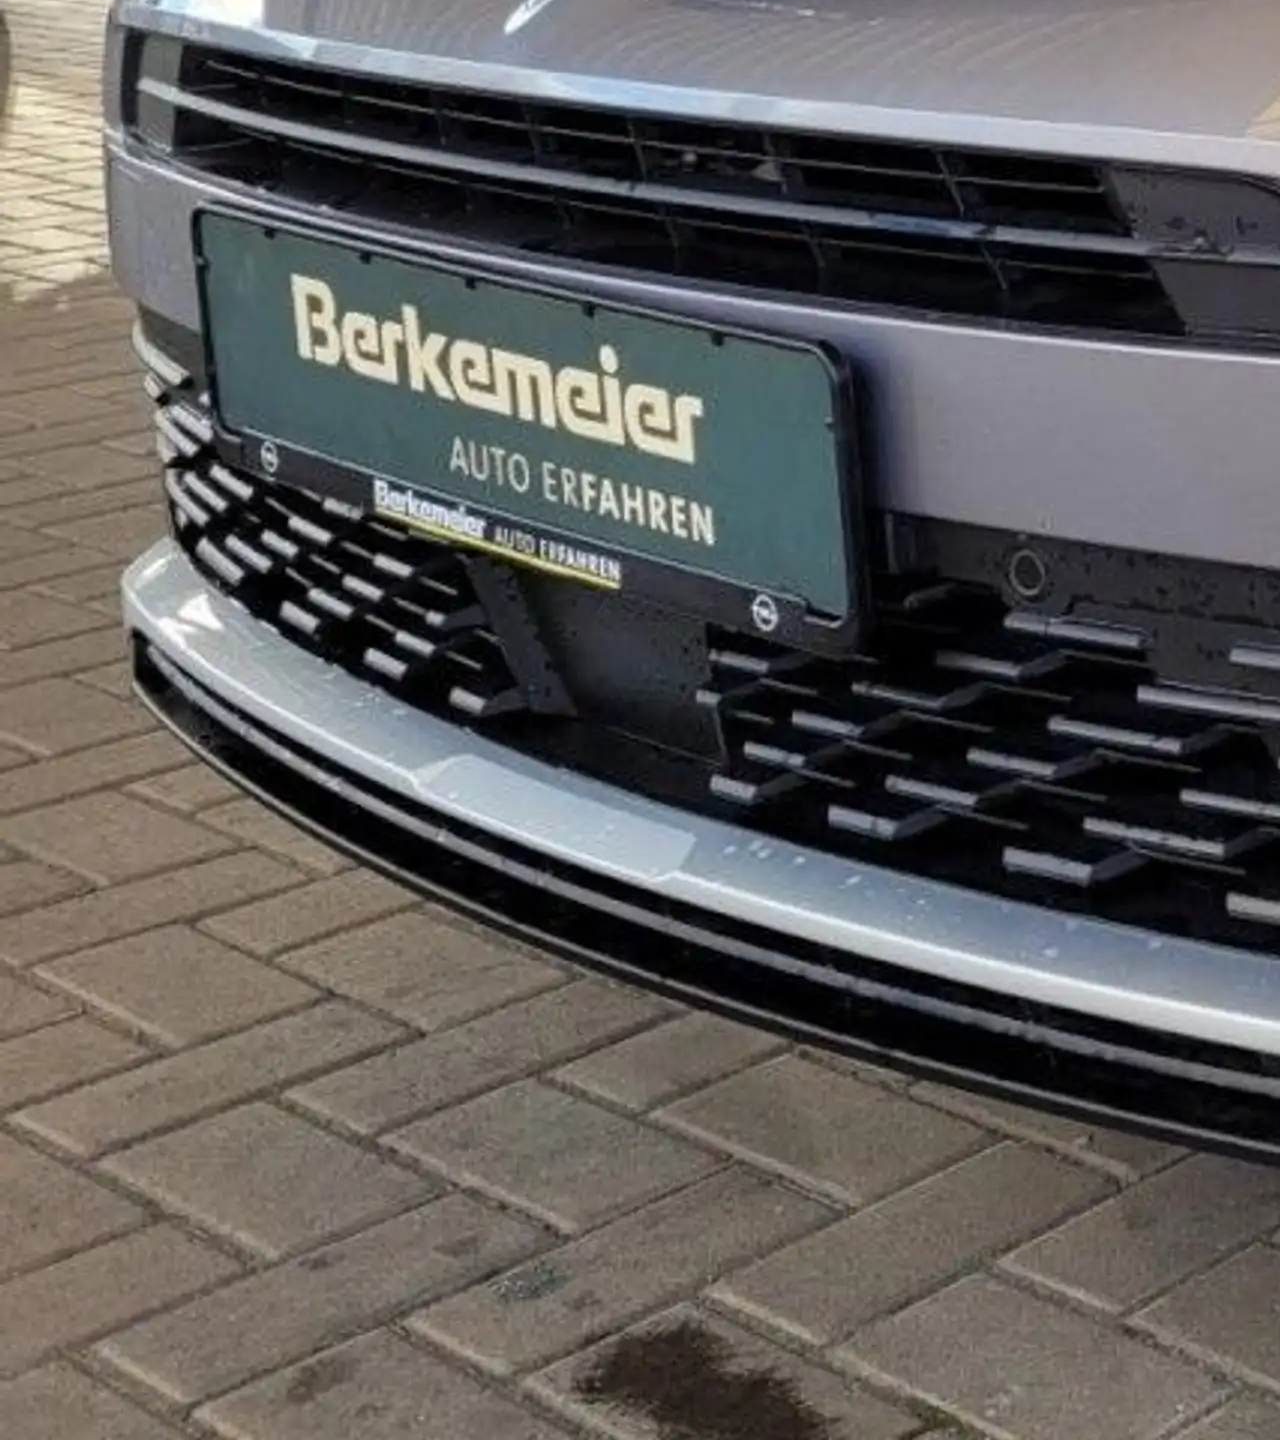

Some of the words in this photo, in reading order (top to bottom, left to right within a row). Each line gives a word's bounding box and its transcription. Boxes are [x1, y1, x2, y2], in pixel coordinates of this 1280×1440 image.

[290, 272, 704, 463] Berkemeier
[373, 478, 487, 539] Berkemeier
[494, 524, 537, 554] AUTO
[450, 434, 531, 494] AUTO
[543, 461, 716, 546] ERFAHREN
